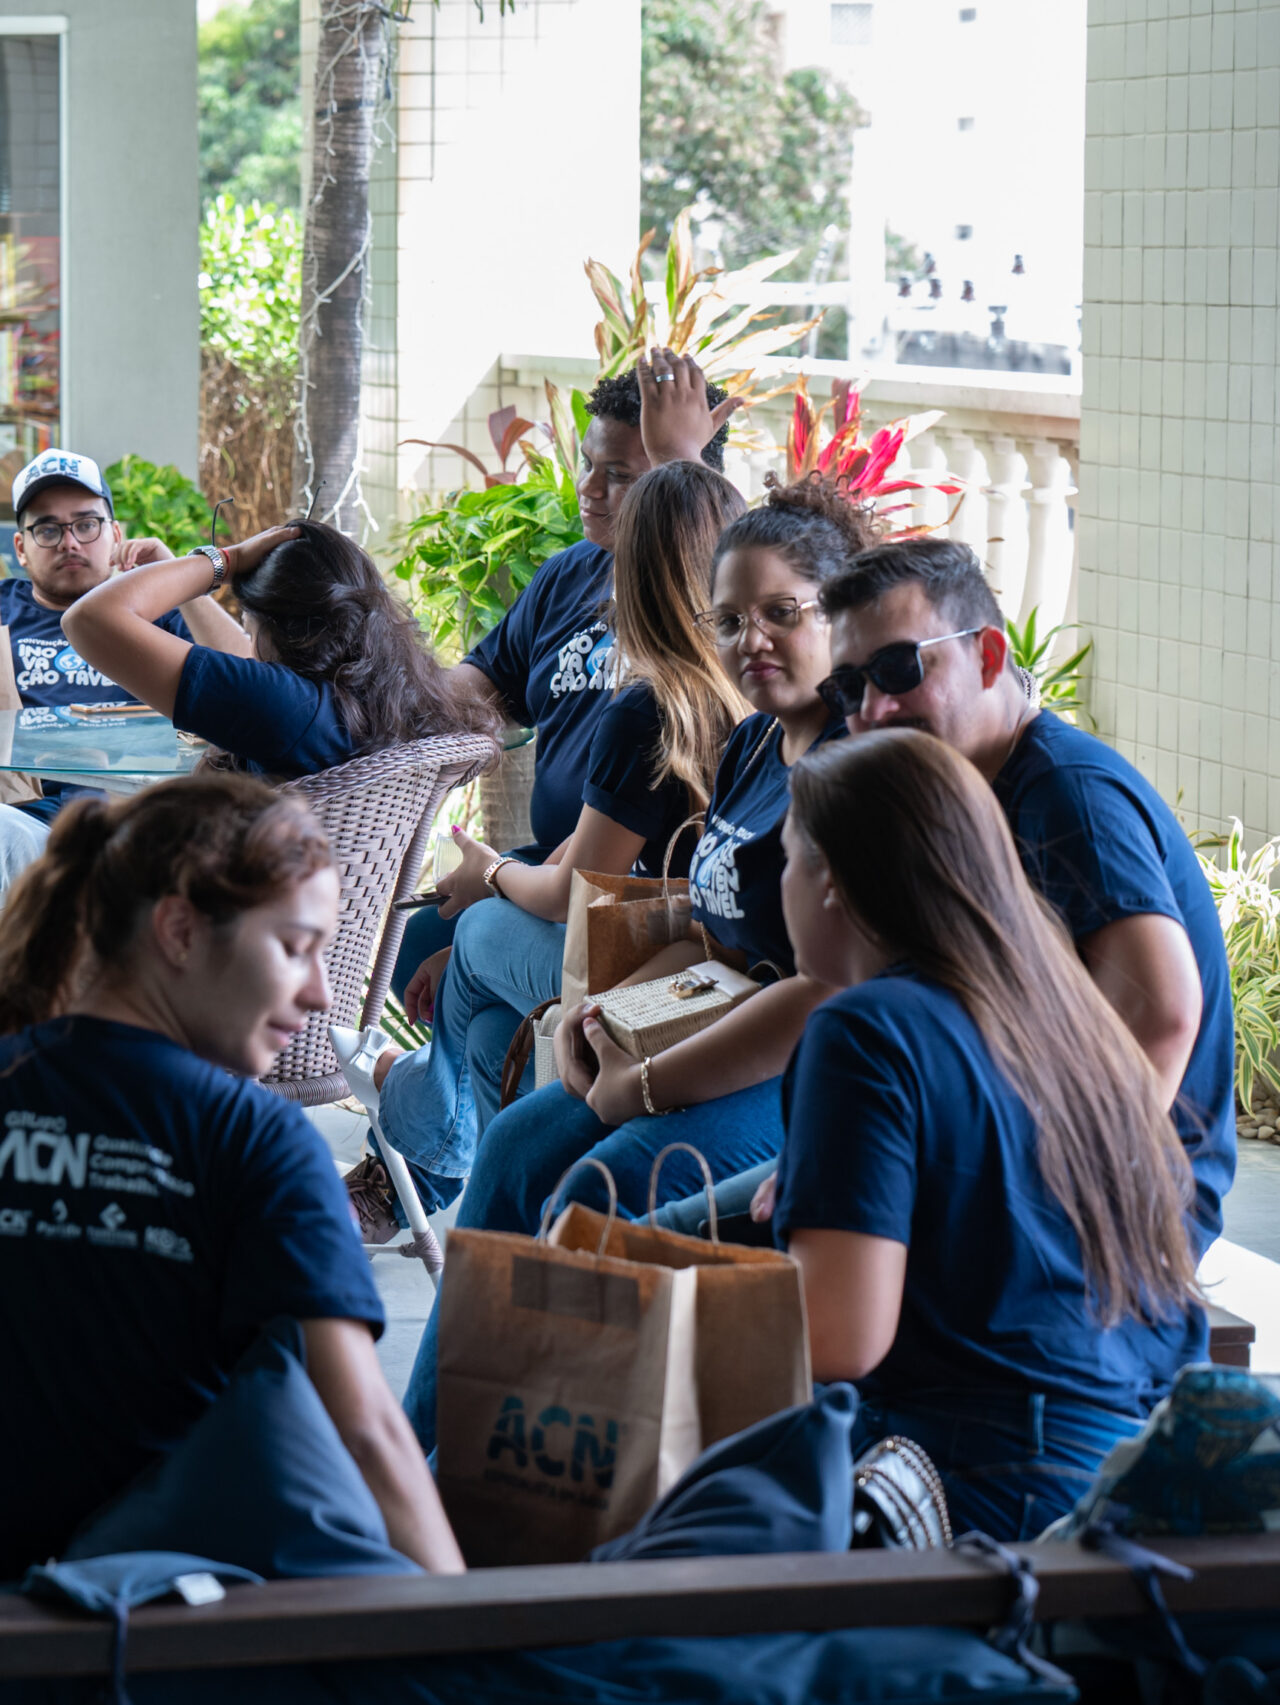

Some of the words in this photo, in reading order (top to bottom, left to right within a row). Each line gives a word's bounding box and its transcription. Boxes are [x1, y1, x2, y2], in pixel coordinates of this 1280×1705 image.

[25, 457, 79, 484] ACN
[19, 644, 57, 658] INO
[558, 652, 583, 673] VA
[22, 656, 49, 670] VA
[17, 668, 59, 691] ÇÃO
[550, 671, 587, 698] ÇÃO
[487, 1396, 618, 1489] ACN
